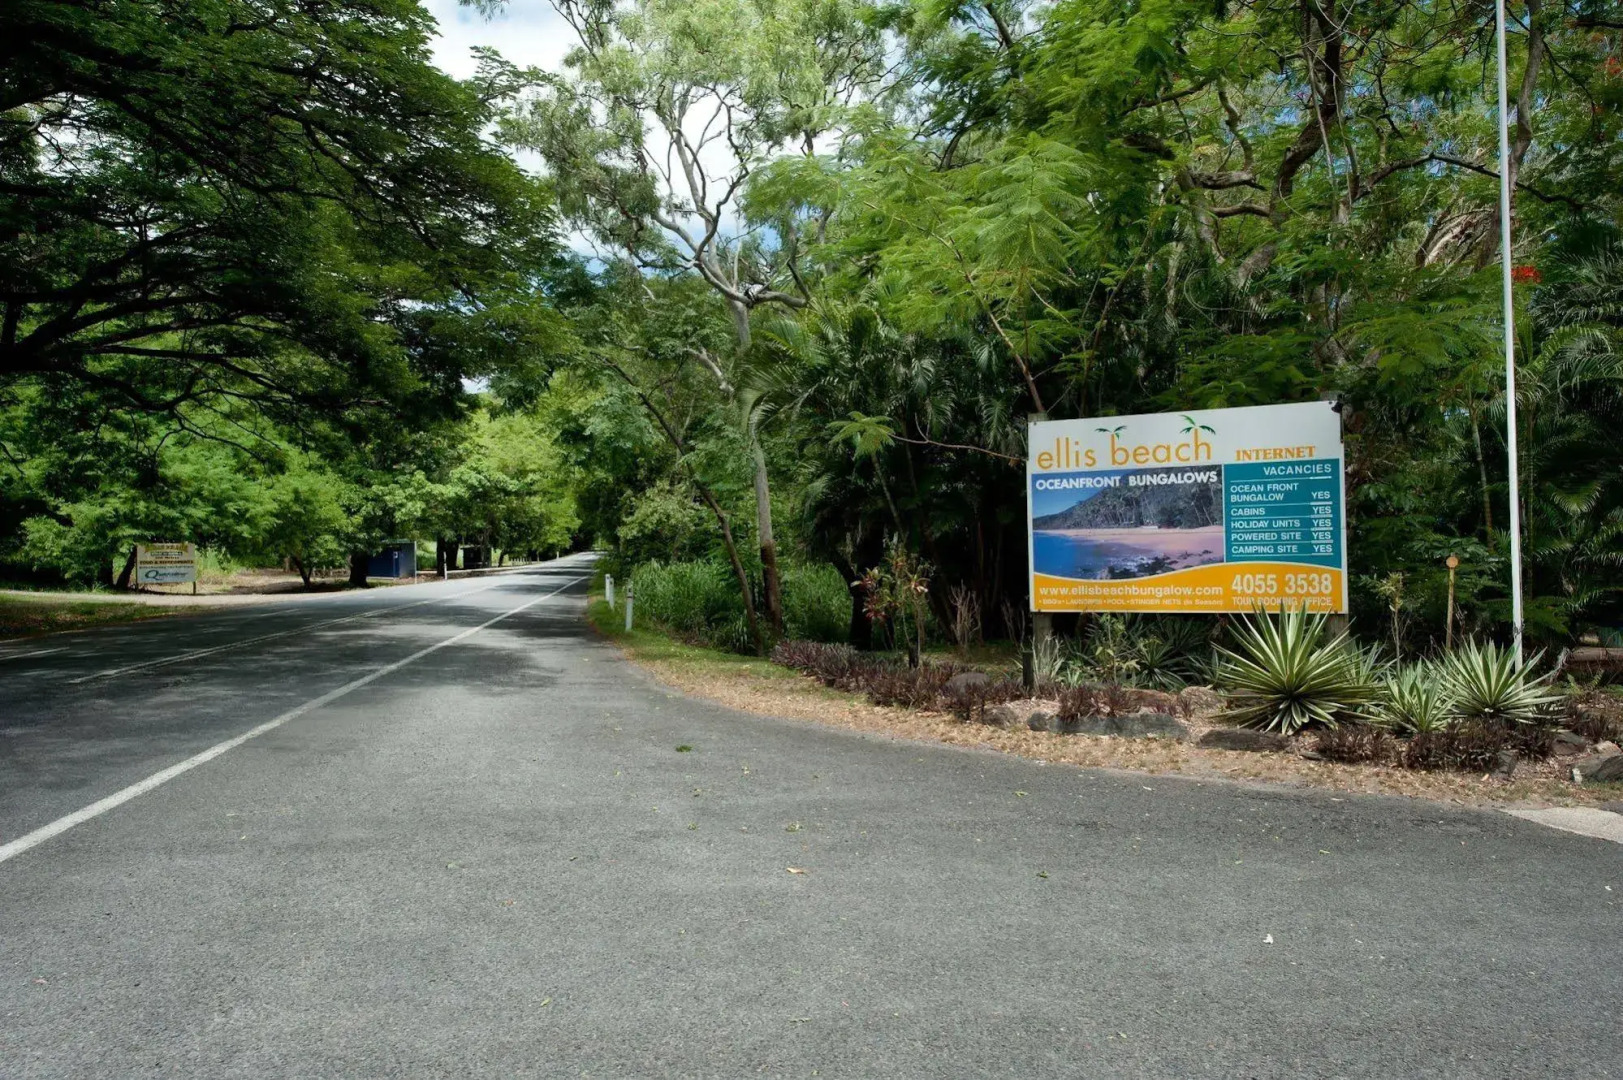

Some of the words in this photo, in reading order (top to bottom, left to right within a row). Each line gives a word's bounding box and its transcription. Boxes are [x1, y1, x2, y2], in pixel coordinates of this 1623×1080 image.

[1037, 437, 1096, 470] ellis
[1111, 428, 1212, 466] beach
[1235, 446, 1315, 461] INTERNET
[1263, 464, 1332, 475] VACANCIES
[1036, 476, 1121, 490] OCEANFRONT
[1128, 471, 1217, 487] BUNGALOWS
[1230, 484, 1264, 493] OCEAN
[1267, 483, 1299, 491] FRONT
[1230, 493, 1284, 502] BUNGALOW
[1311, 491, 1331, 499] YES
[1231, 508, 1266, 516] CABINS
[1312, 506, 1331, 514] YES
[1231, 520, 1269, 529] HOLIDAY
[1272, 520, 1300, 528] UNITS
[1312, 519, 1331, 527] YES
[1231, 532, 1277, 541] POWERED
[1281, 532, 1302, 540] SITE
[1312, 531, 1331, 539] YES
[1231, 545, 1274, 554] CAMPING
[1277, 545, 1298, 553] SITE
[1313, 544, 1332, 553] YES
[1231, 574, 1278, 594] 4055
[1284, 573, 1333, 594] 3538
[1039, 584, 1223, 598] www.ellisbeachbungalow.com
